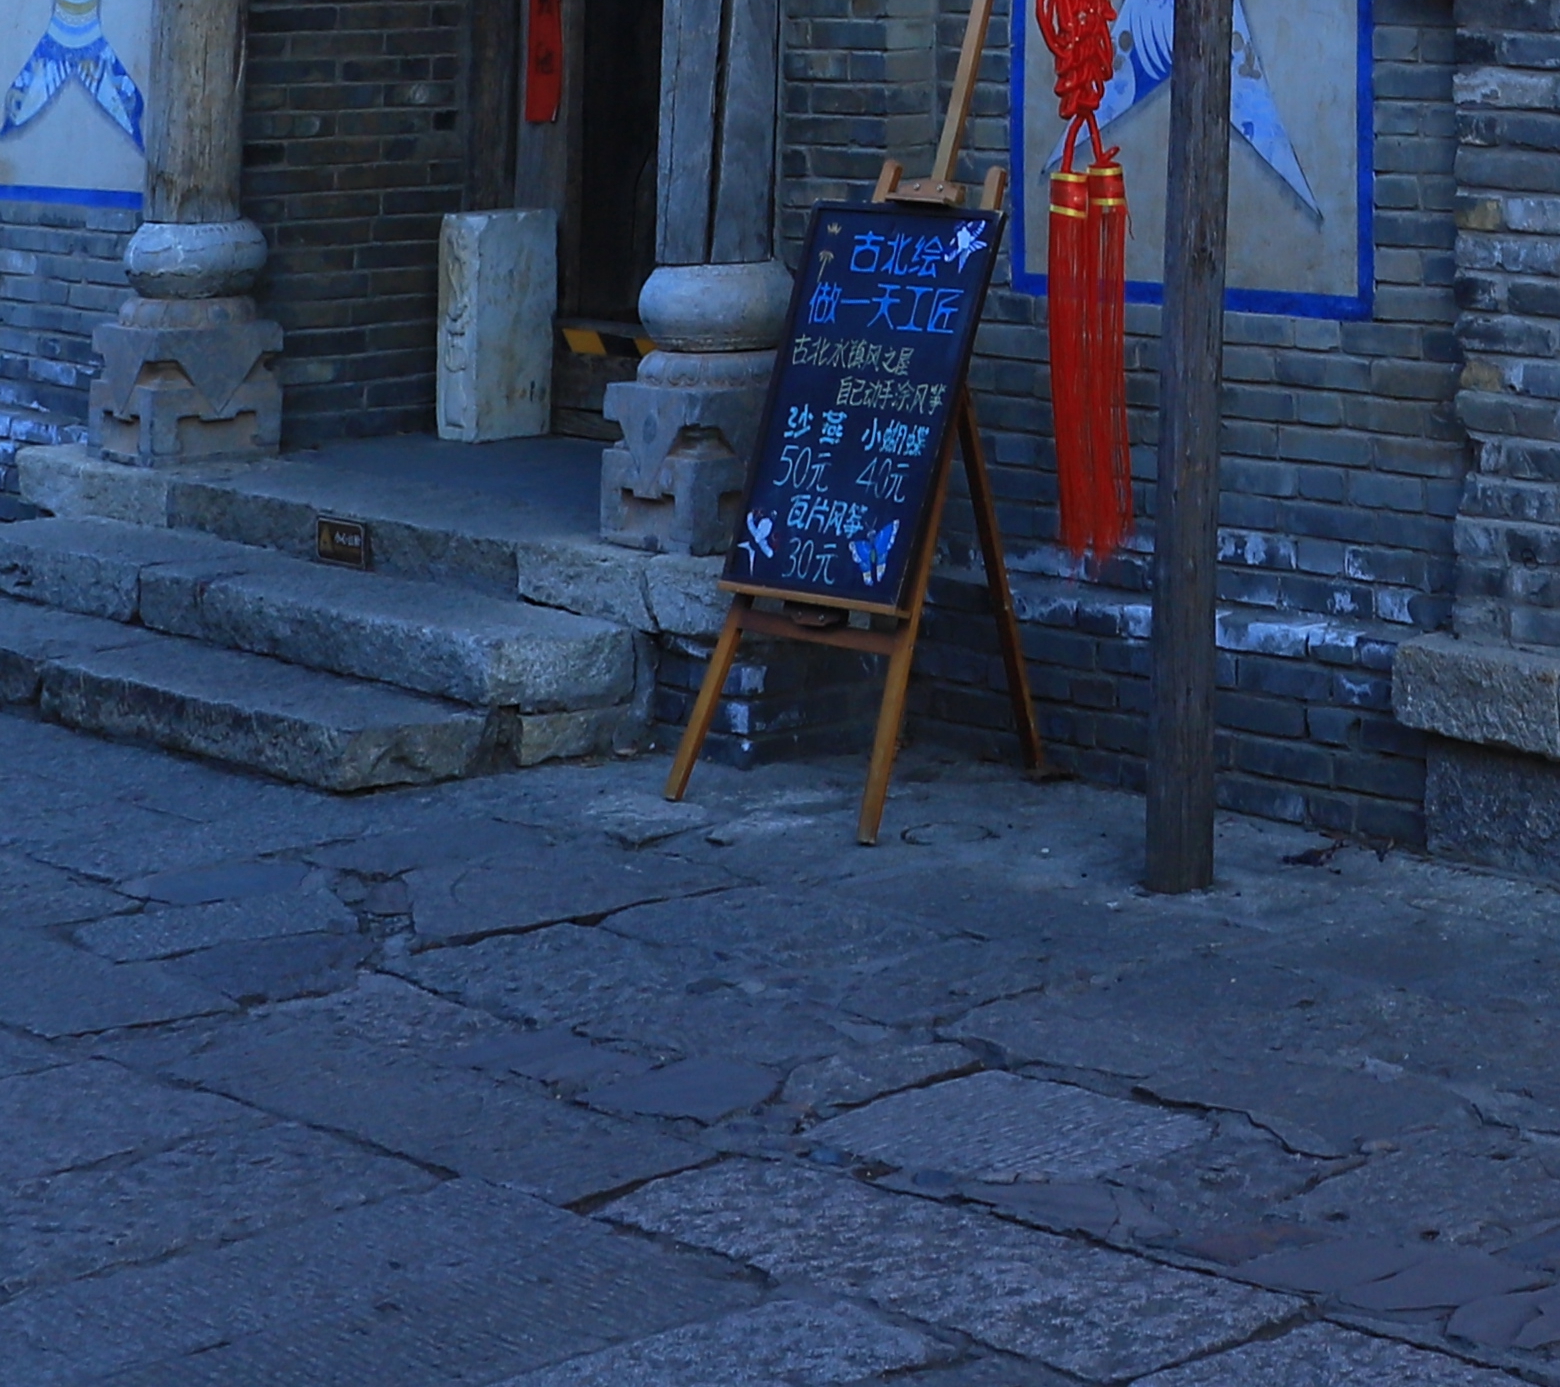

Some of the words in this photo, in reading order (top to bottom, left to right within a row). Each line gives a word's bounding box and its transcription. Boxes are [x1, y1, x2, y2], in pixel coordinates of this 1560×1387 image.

[850, 230, 944, 278] 古北绘
[808, 281, 964, 334] 做一天工匠
[792, 333, 914, 376] 古北水镇风之屋
[861, 417, 930, 456] 小蝴蝶
[773, 445, 832, 492] 50元
[855, 456, 910, 503] 40元
[781, 537, 839, 585] 30元
